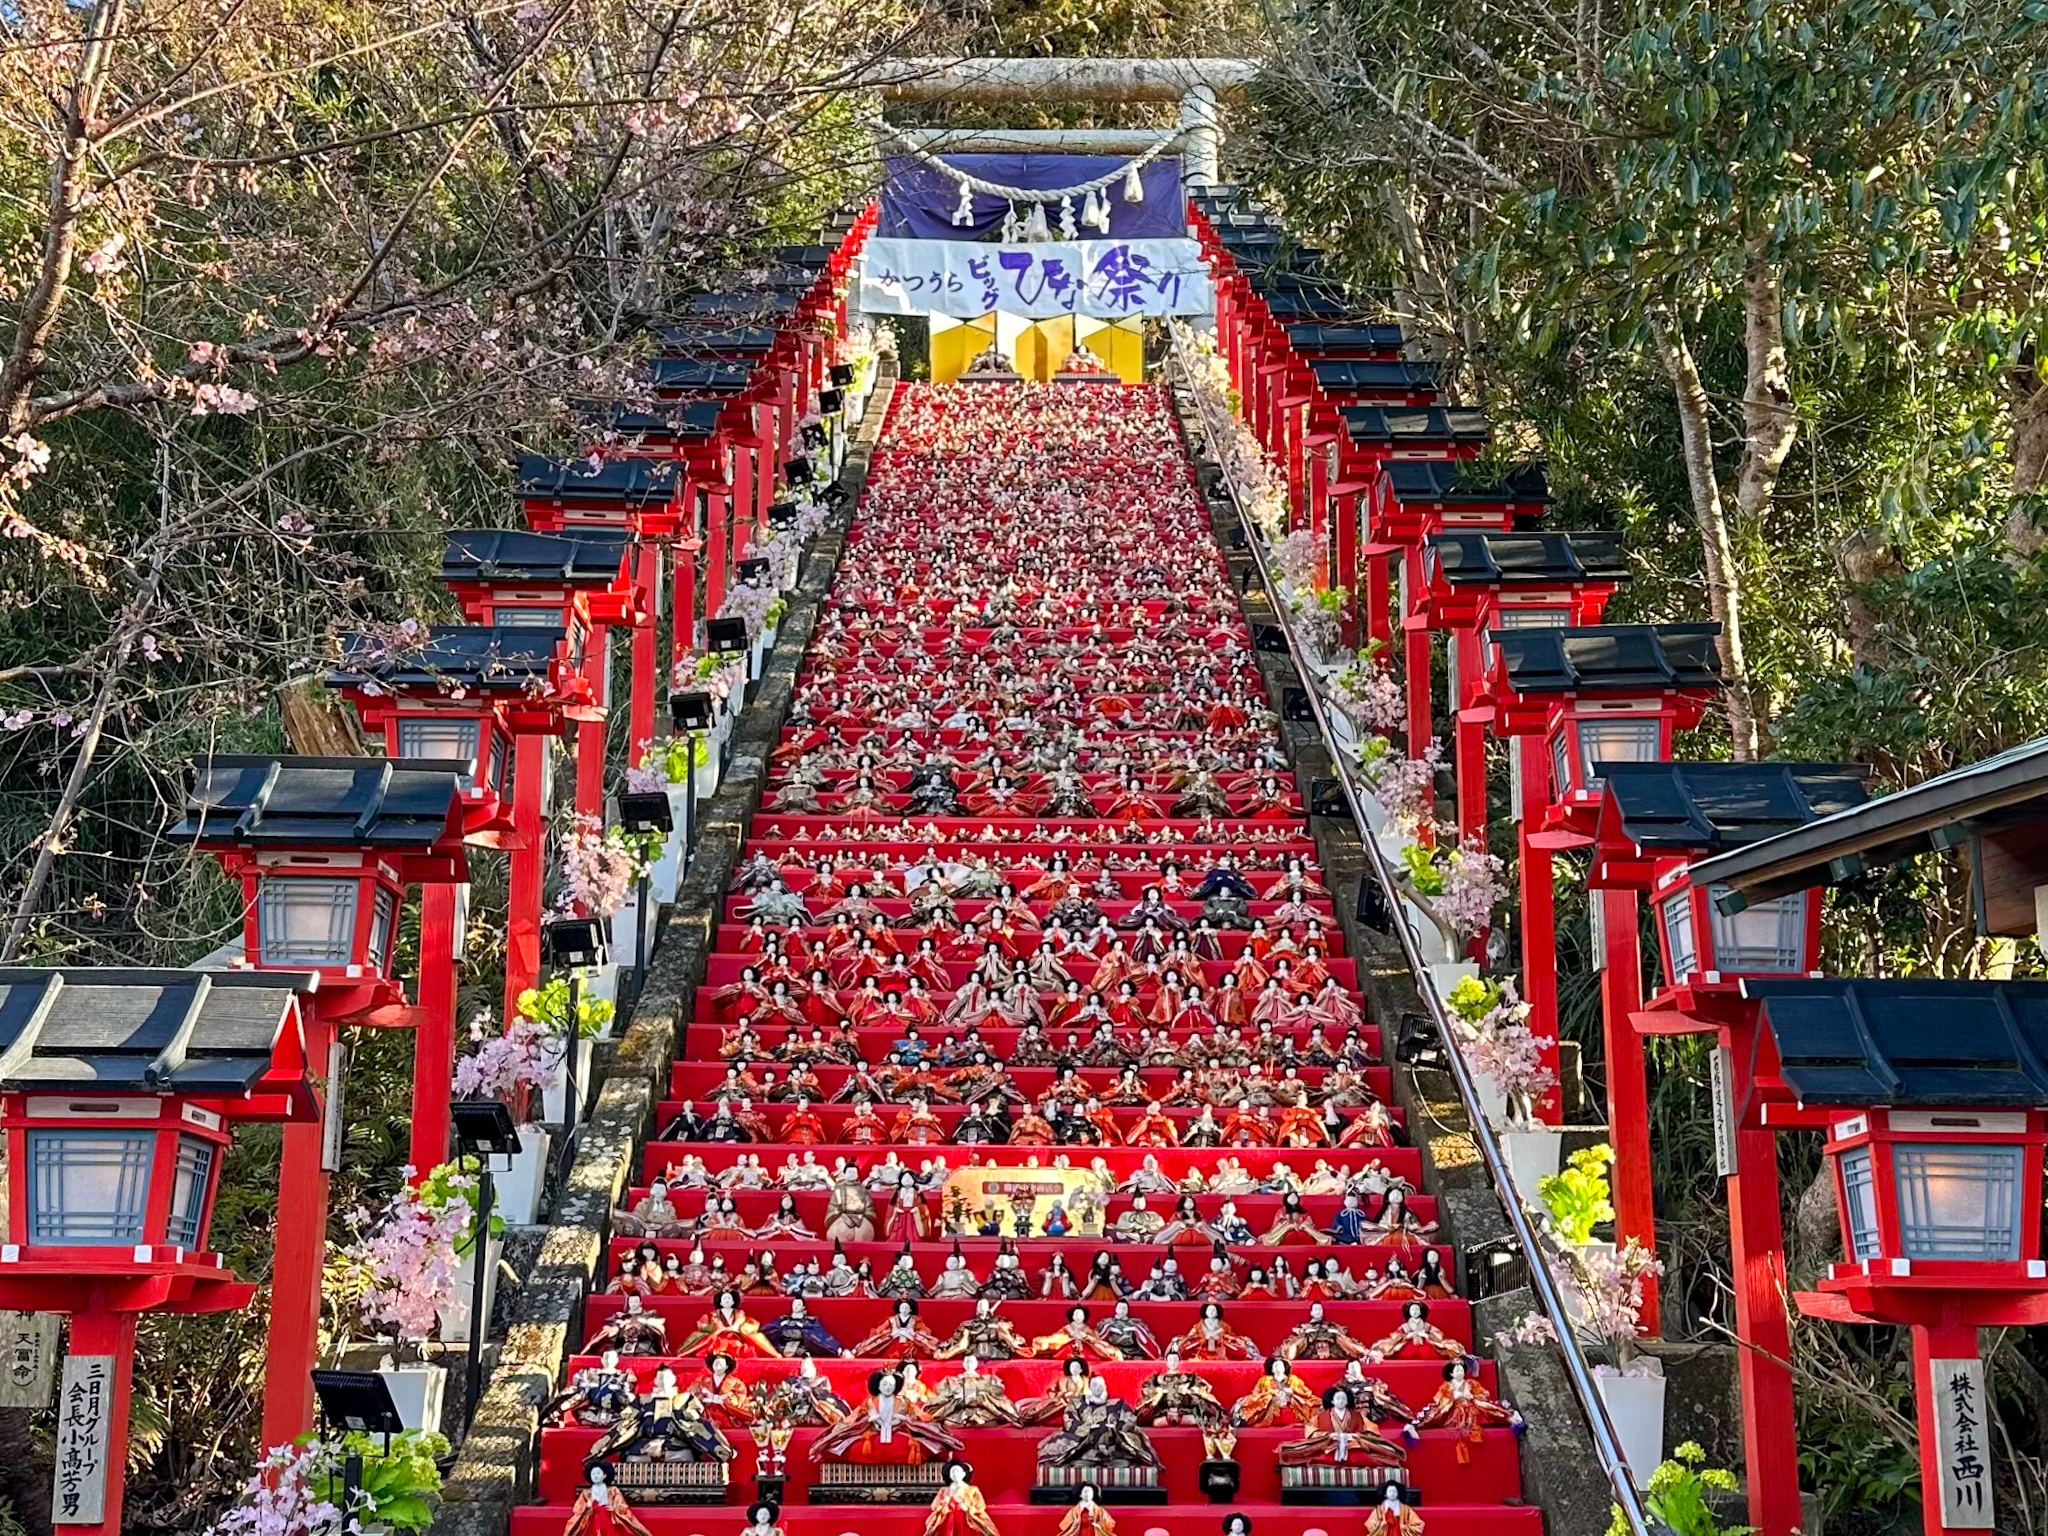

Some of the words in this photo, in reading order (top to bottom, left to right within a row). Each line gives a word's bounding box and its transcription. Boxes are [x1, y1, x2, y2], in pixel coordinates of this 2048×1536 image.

[877, 267, 964, 293] かつうら
[968, 254, 999, 311] ビッグ
[998, 245, 1181, 313] ひな祭り
[83, 1364, 105, 1476] 三日月グループ
[1950, 1372, 1984, 1514] 株式会社西川
